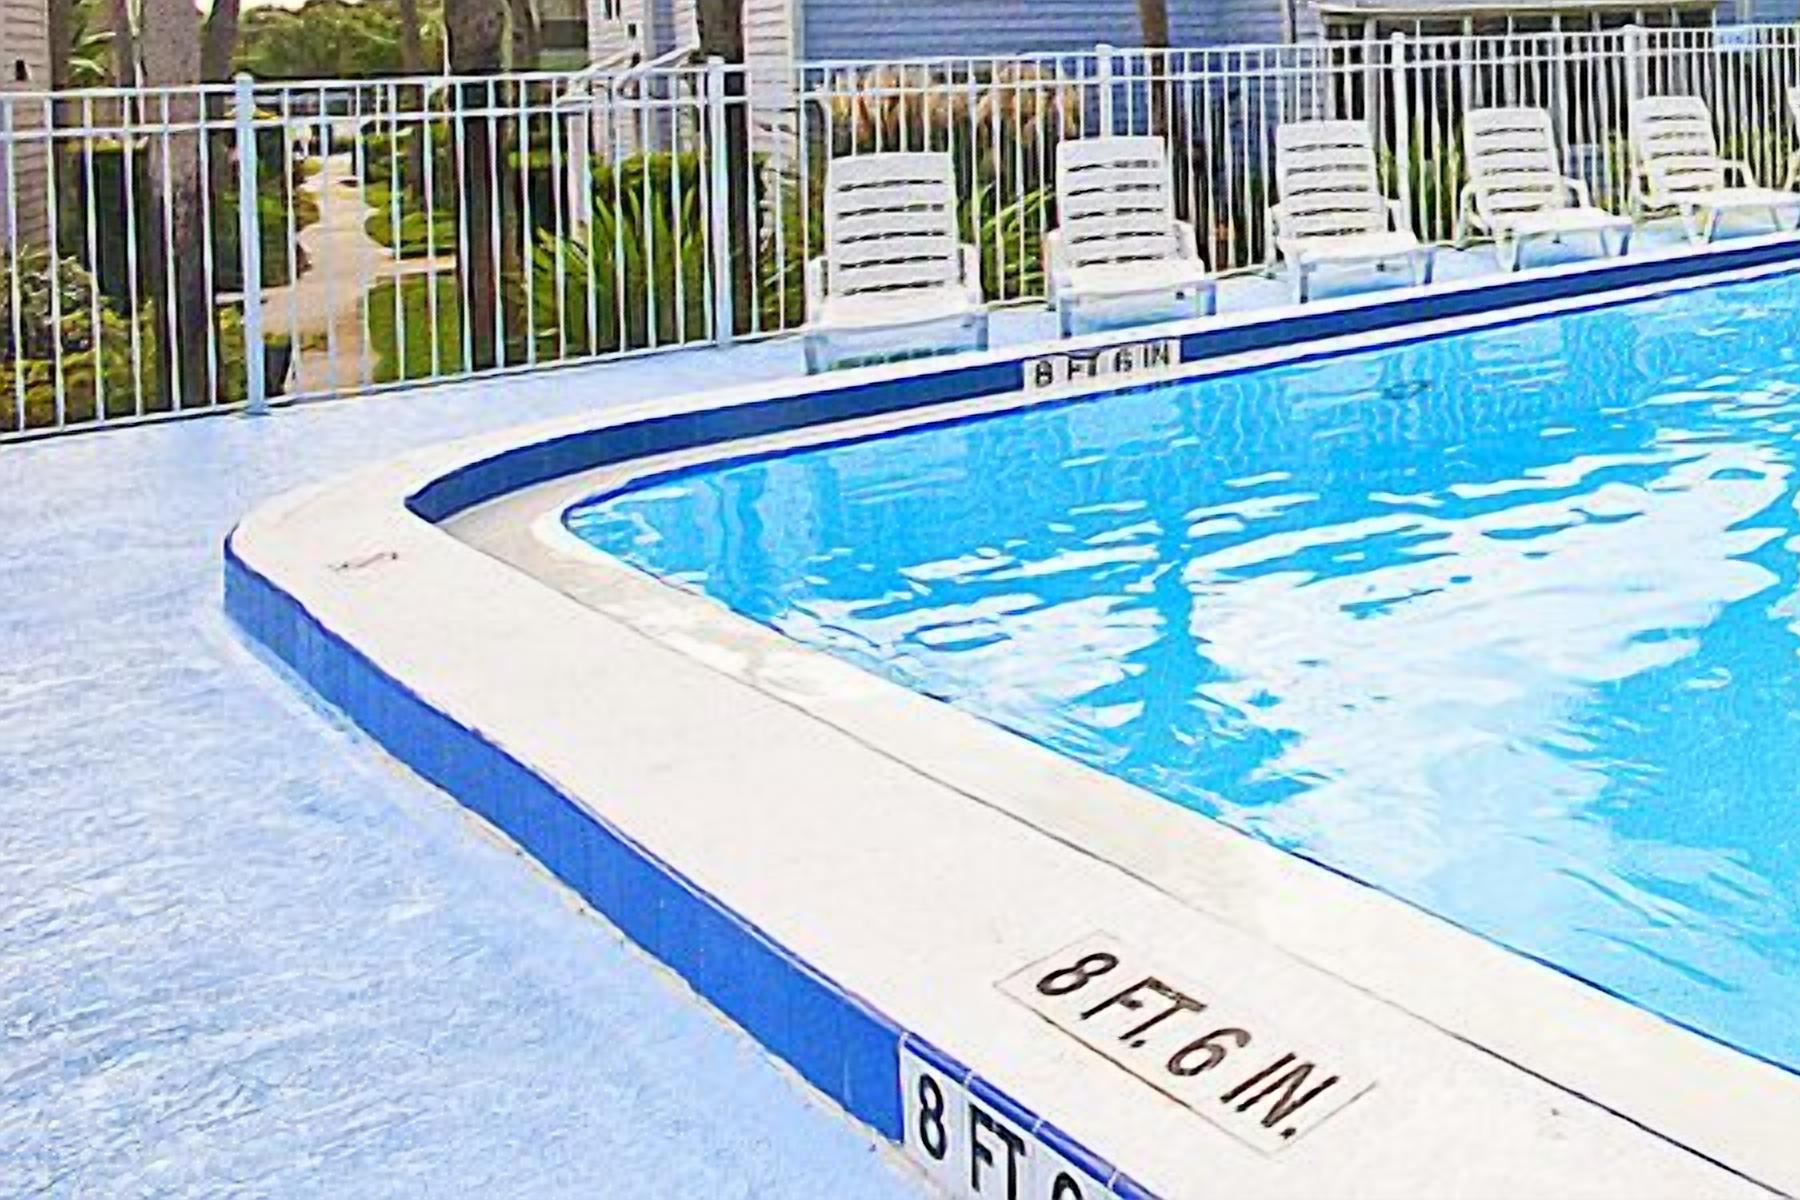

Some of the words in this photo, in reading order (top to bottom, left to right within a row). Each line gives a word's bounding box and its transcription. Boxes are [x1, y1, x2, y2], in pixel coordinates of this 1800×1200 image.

[1036, 952, 1119, 996] 8
[1080, 976, 1207, 1048] FT.
[1166, 1027, 1251, 1077] 6
[1220, 1052, 1339, 1139] IN.
[918, 1072, 947, 1161] 8
